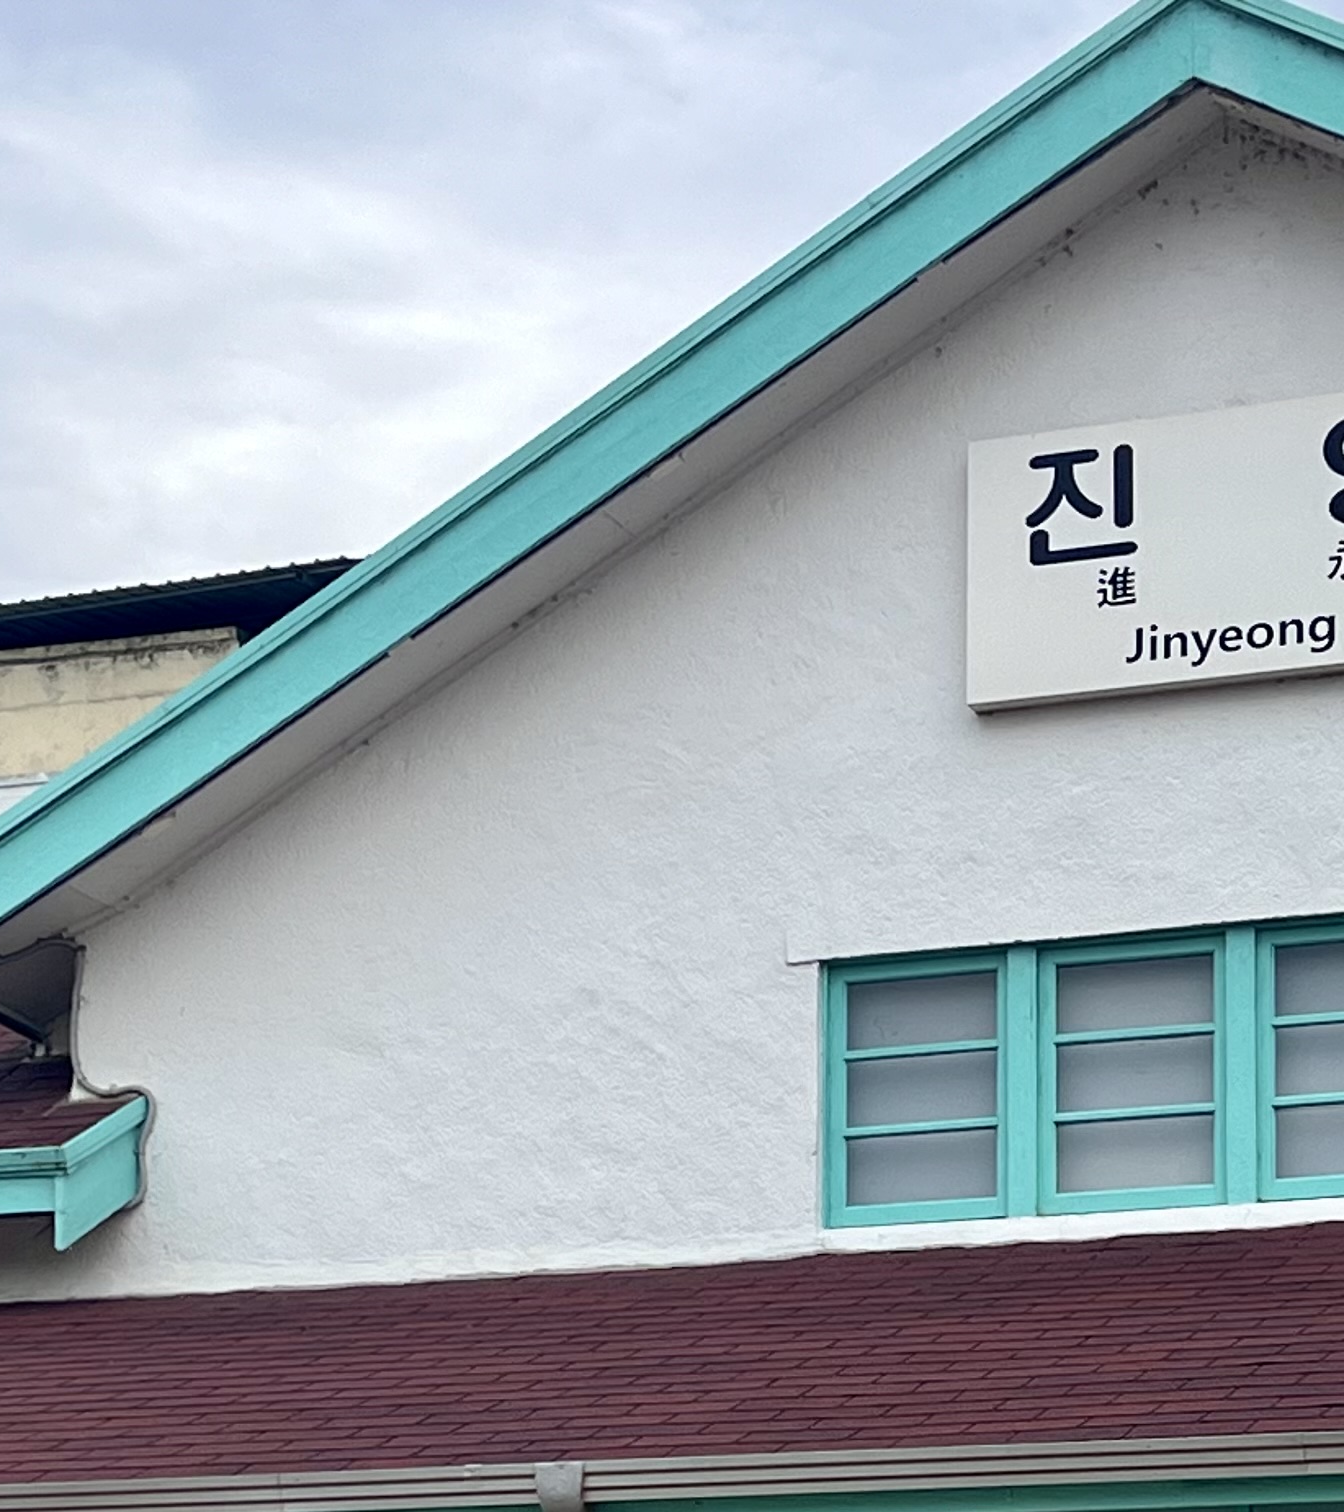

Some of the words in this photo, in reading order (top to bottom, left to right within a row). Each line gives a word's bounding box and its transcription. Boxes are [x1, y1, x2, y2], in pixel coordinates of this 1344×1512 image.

[1025, 443, 1138, 566] 진
[1096, 566, 1136, 608] 進
[1126, 614, 1336, 667] Jinyeong
